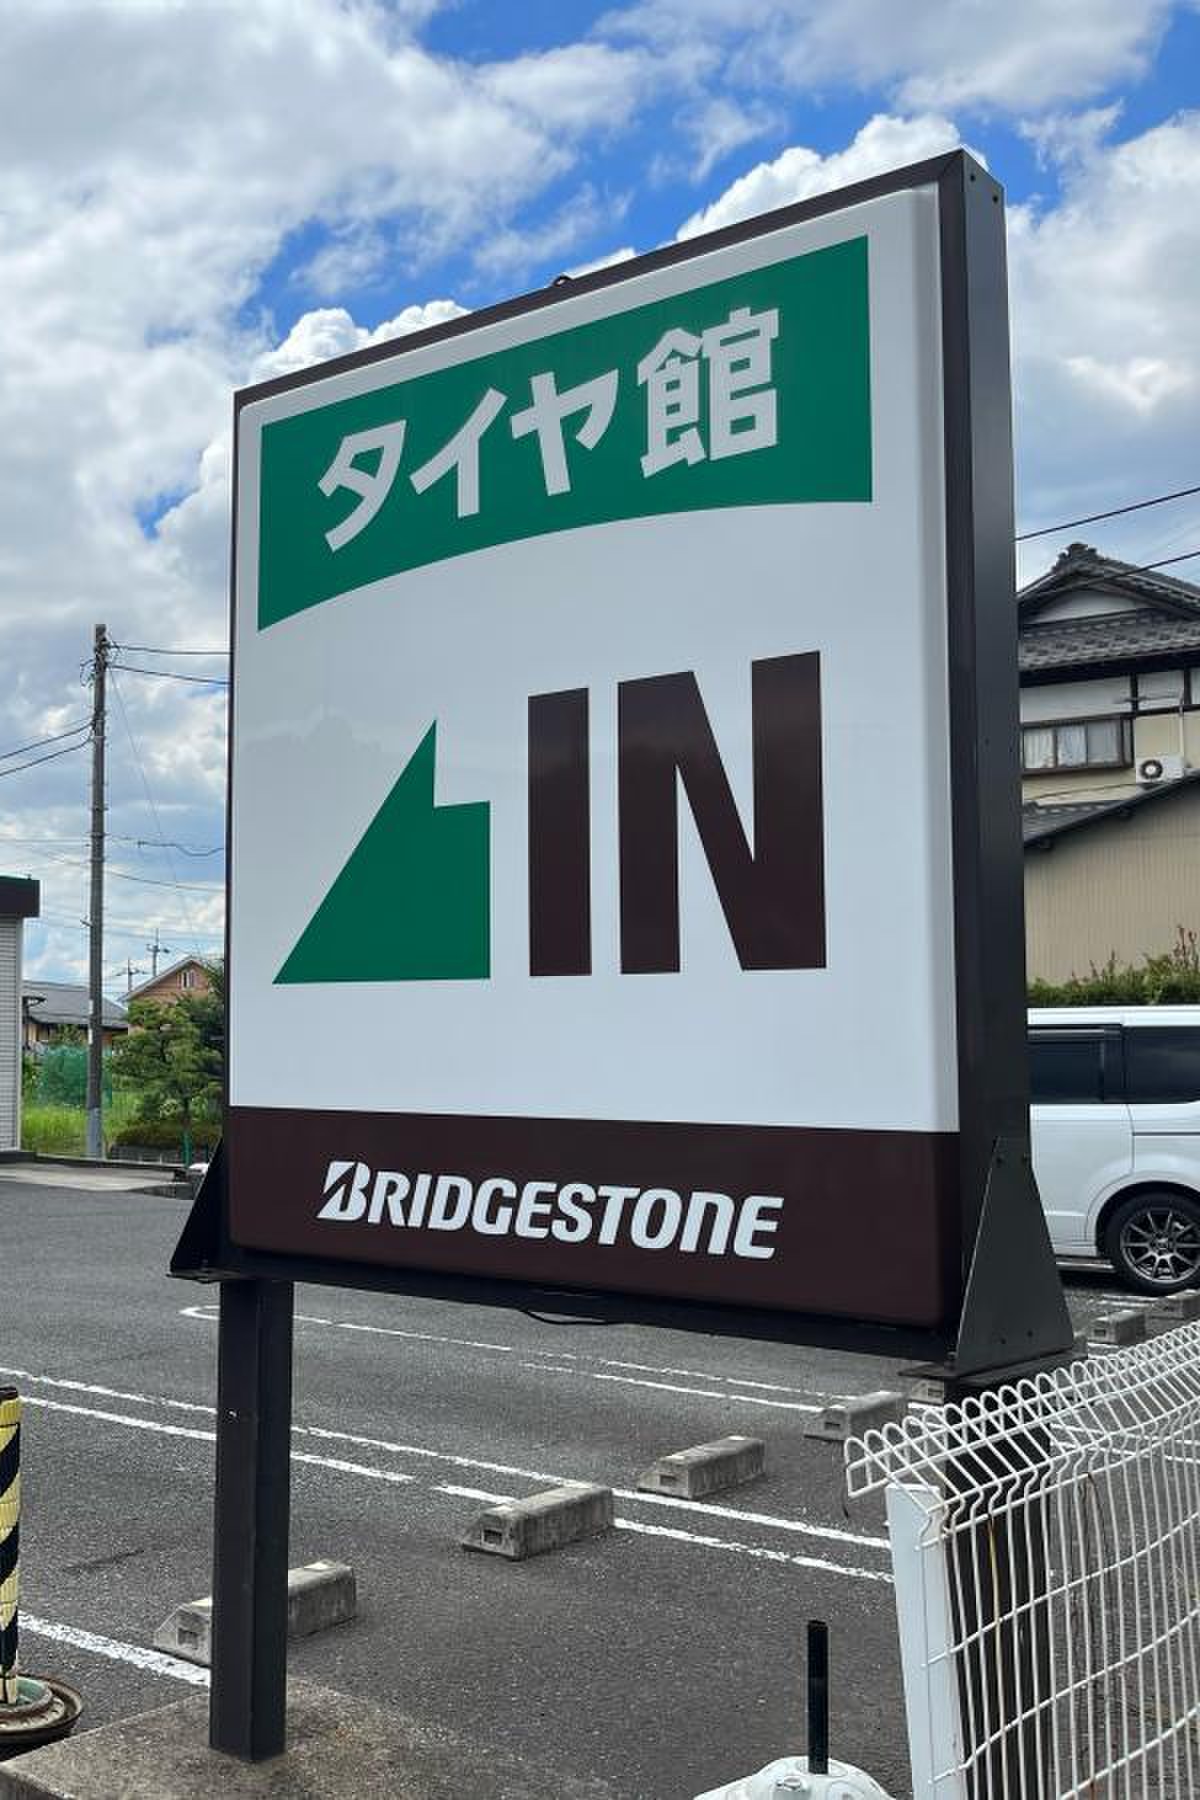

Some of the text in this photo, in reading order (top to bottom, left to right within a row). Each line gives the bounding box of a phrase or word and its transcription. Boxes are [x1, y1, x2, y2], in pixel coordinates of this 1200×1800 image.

[317, 306, 780, 553] タイヤ館
[527, 650, 827, 978] IN
[316, 1160, 784, 1260] BRIDGESTONE
